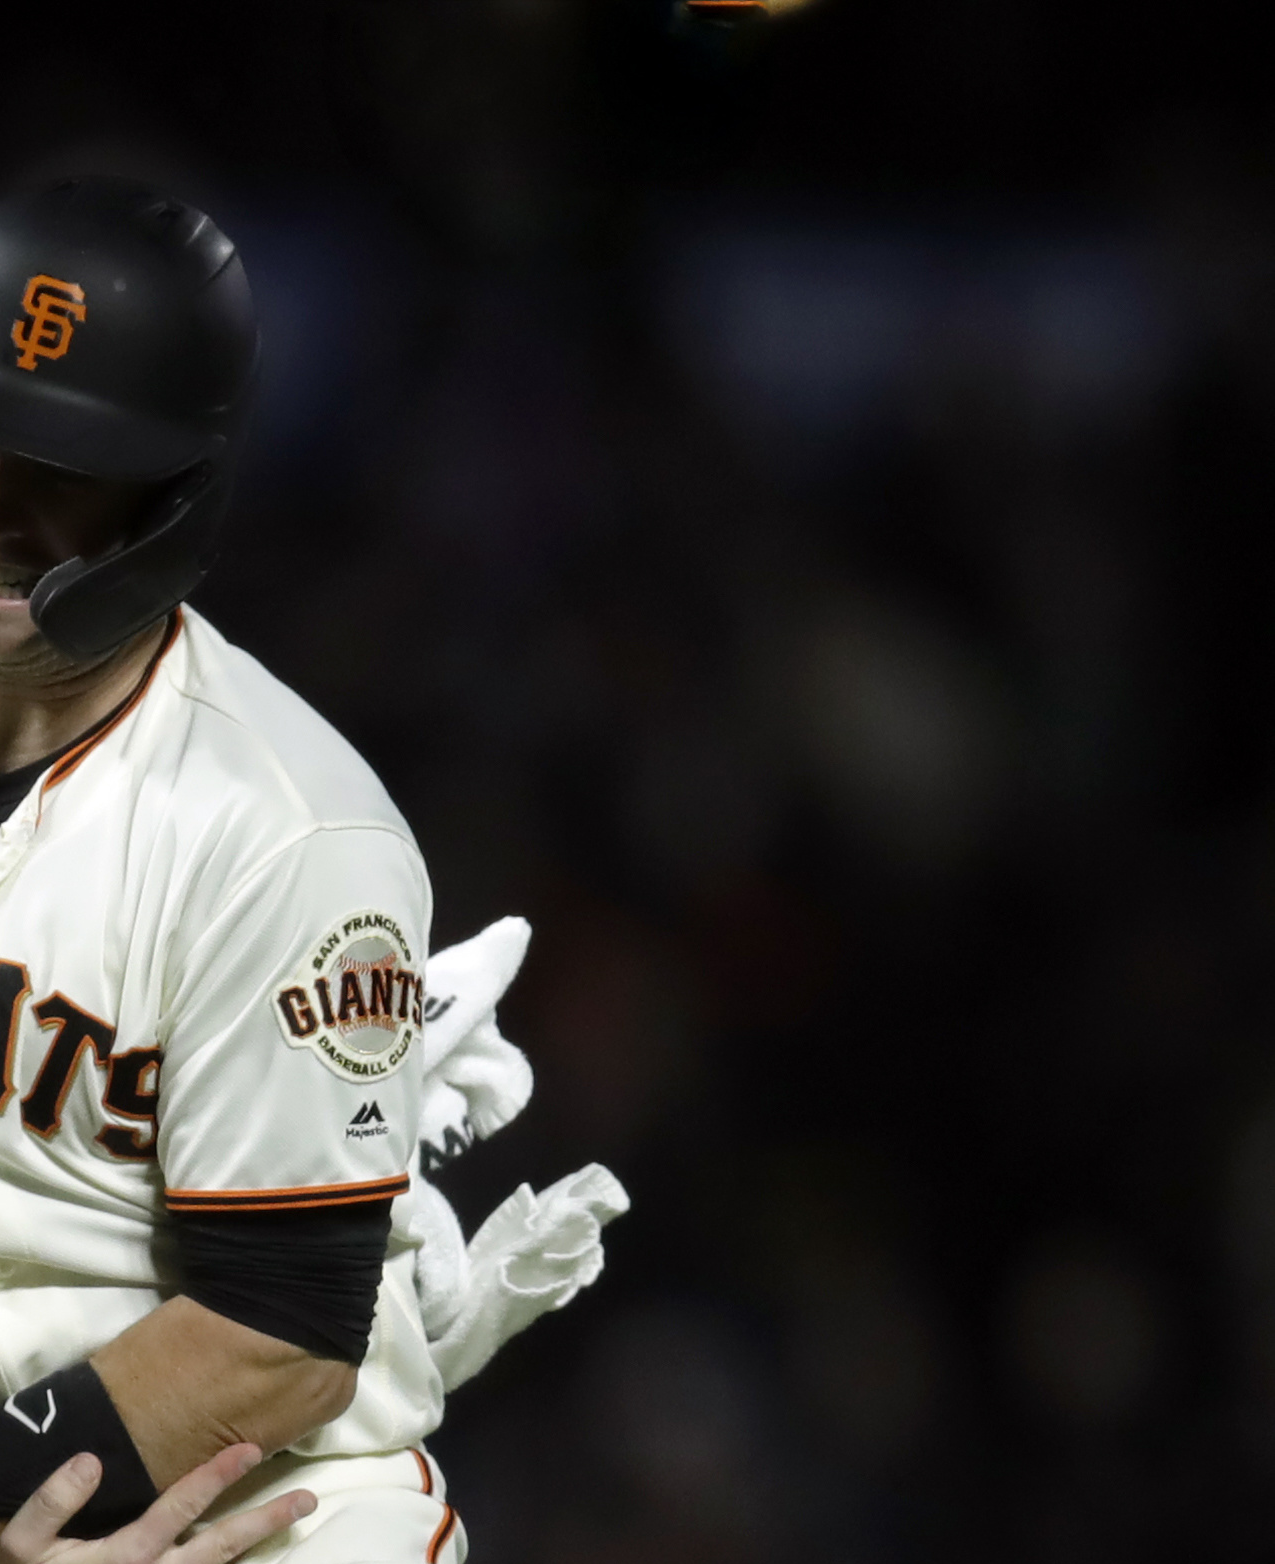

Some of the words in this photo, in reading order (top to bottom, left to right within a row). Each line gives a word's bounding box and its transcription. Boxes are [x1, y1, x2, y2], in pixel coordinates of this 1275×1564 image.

[11, 274, 87, 371] SF
[313, 933, 341, 970] SAN
[343, 914, 411, 962] FRANCISCO
[318, 1035, 388, 1075] BASEBALL
[389, 1029, 412, 1066] CLUB
[346, 1123, 389, 1141] Majestic
